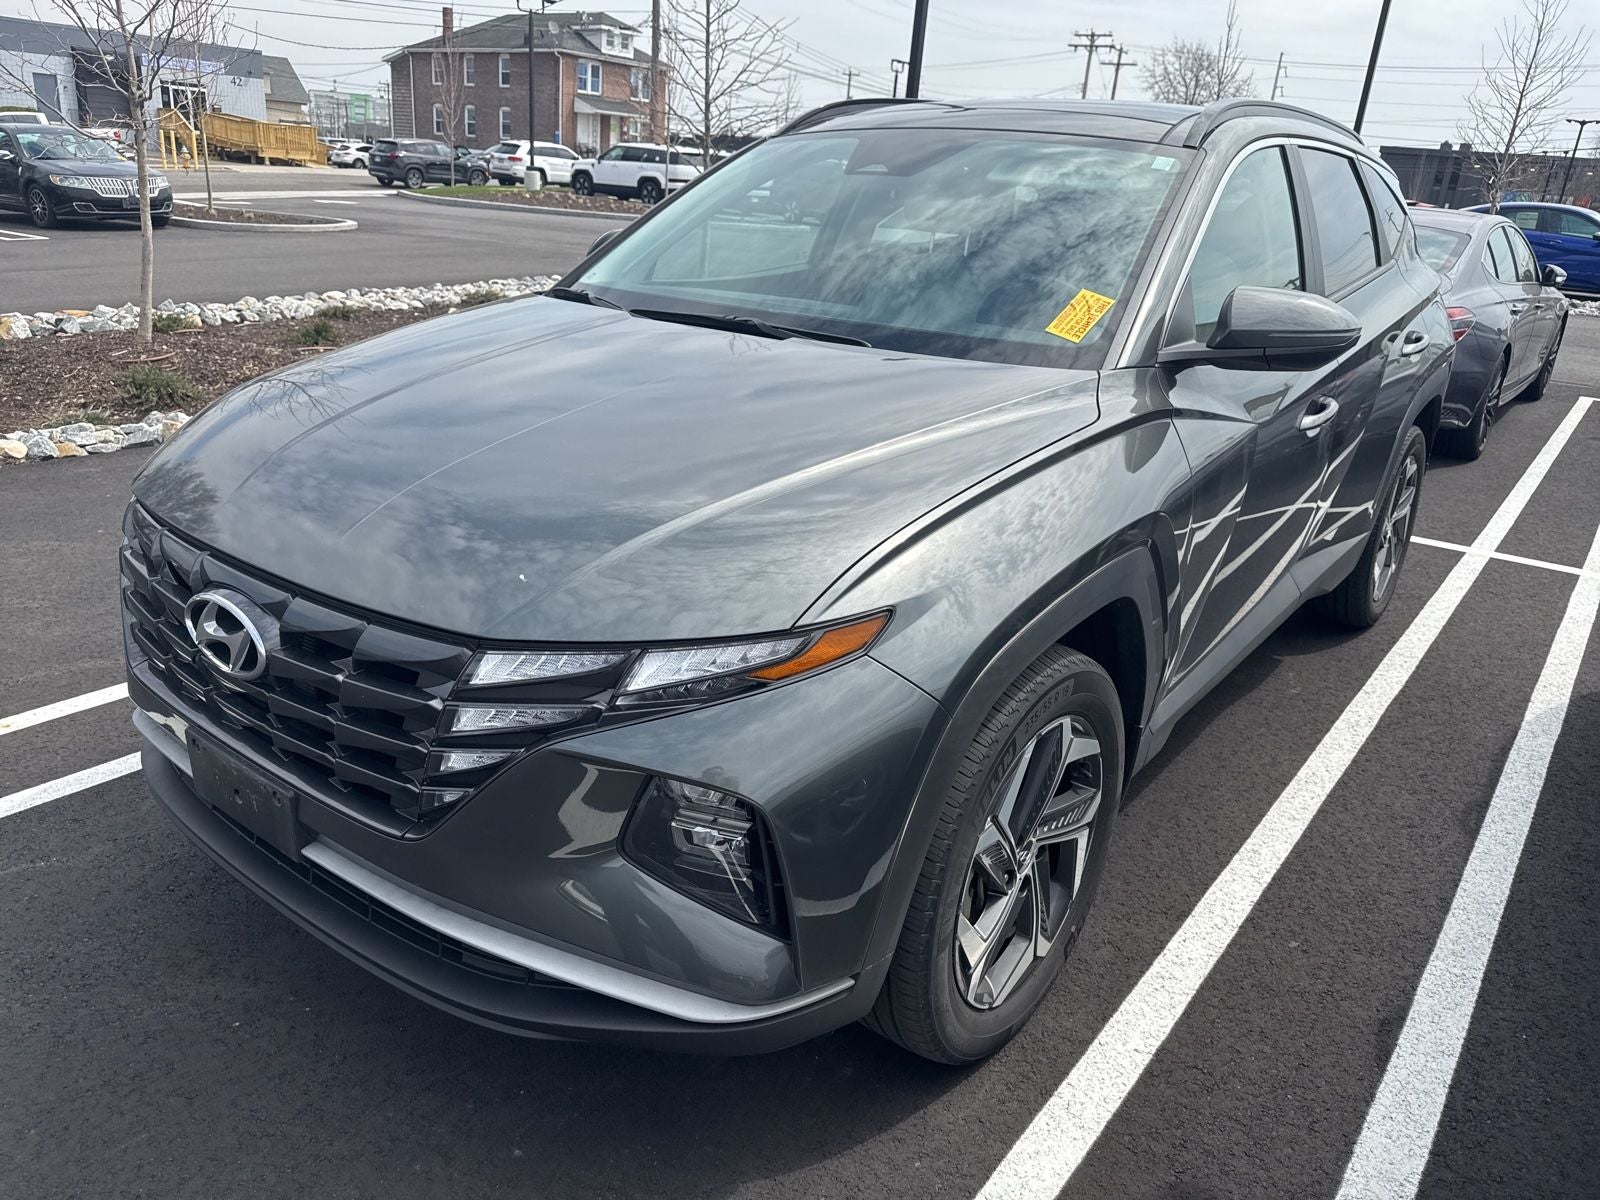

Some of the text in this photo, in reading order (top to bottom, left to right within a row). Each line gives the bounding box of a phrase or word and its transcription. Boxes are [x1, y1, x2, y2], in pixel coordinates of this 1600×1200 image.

[230, 76, 243, 87] 42
[1093, 299, 1111, 314] THIS
[1070, 312, 1099, 340] VEHICLE
